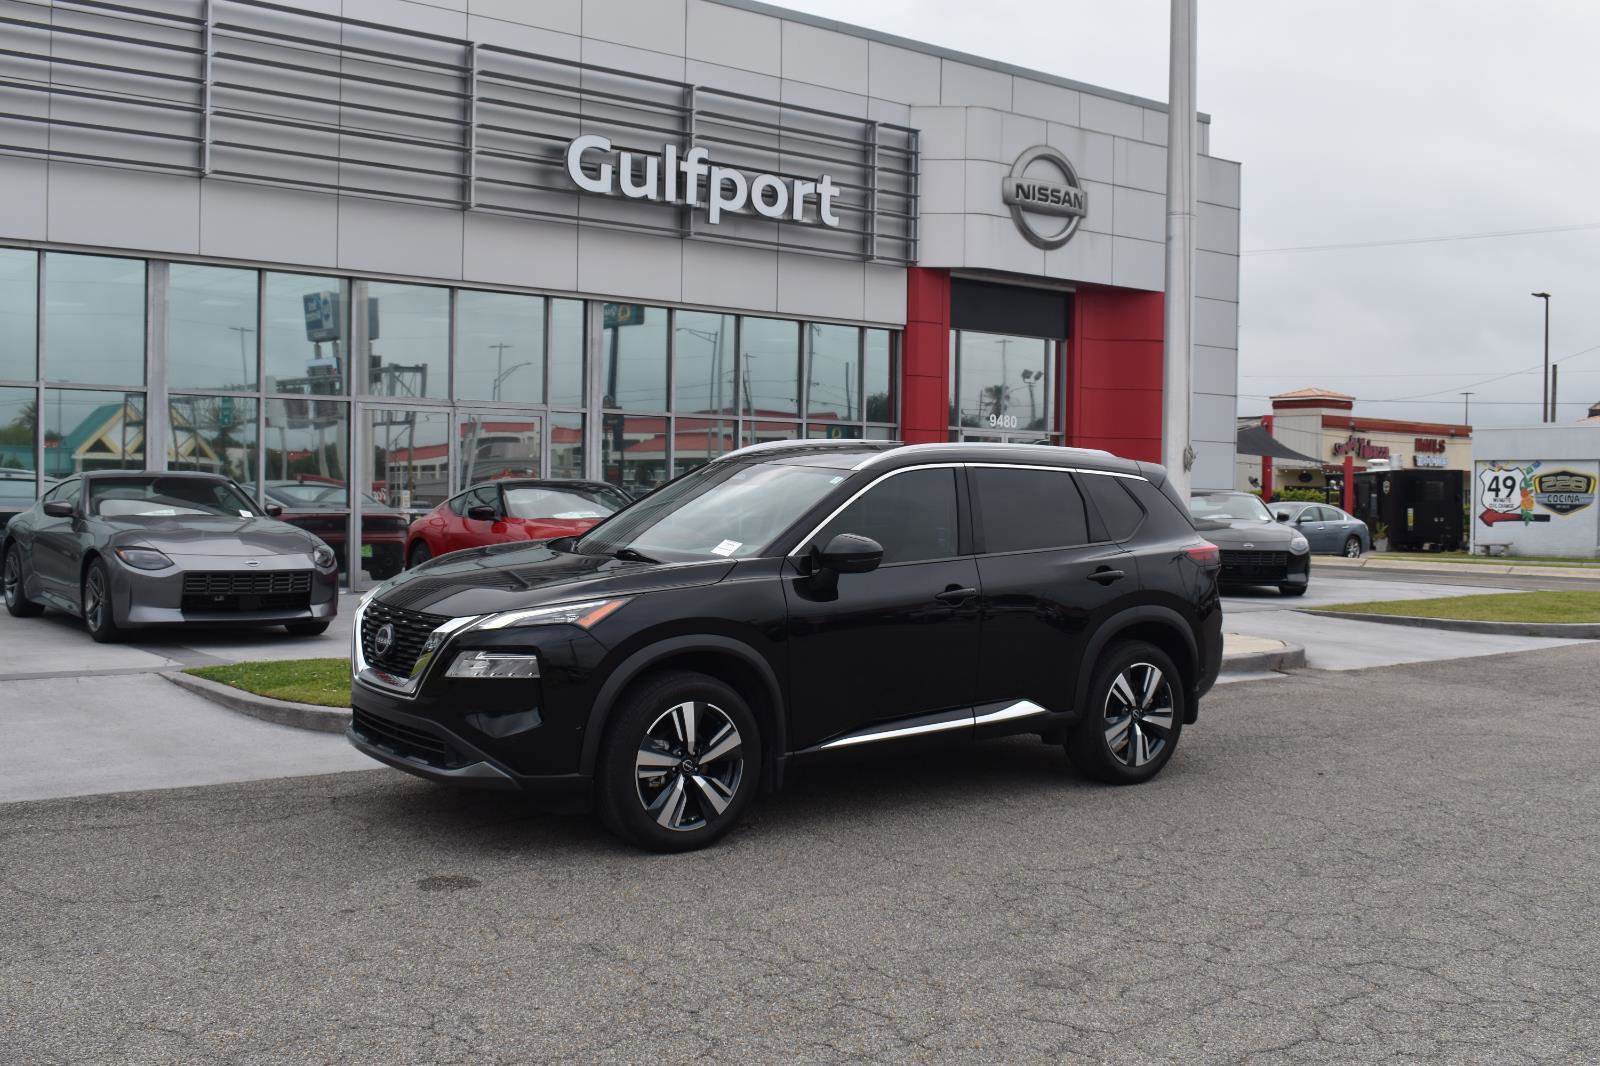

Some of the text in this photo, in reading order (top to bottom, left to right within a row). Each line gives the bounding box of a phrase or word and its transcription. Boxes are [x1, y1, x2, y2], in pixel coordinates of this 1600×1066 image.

[566, 134, 840, 227] Gulfport
[1015, 183, 1083, 209] NISSAN
[989, 414, 1017, 428] 9480
[1487, 475, 1516, 498] 49
[1541, 475, 1587, 492] 228
[1547, 494, 1580, 503] COCINA
